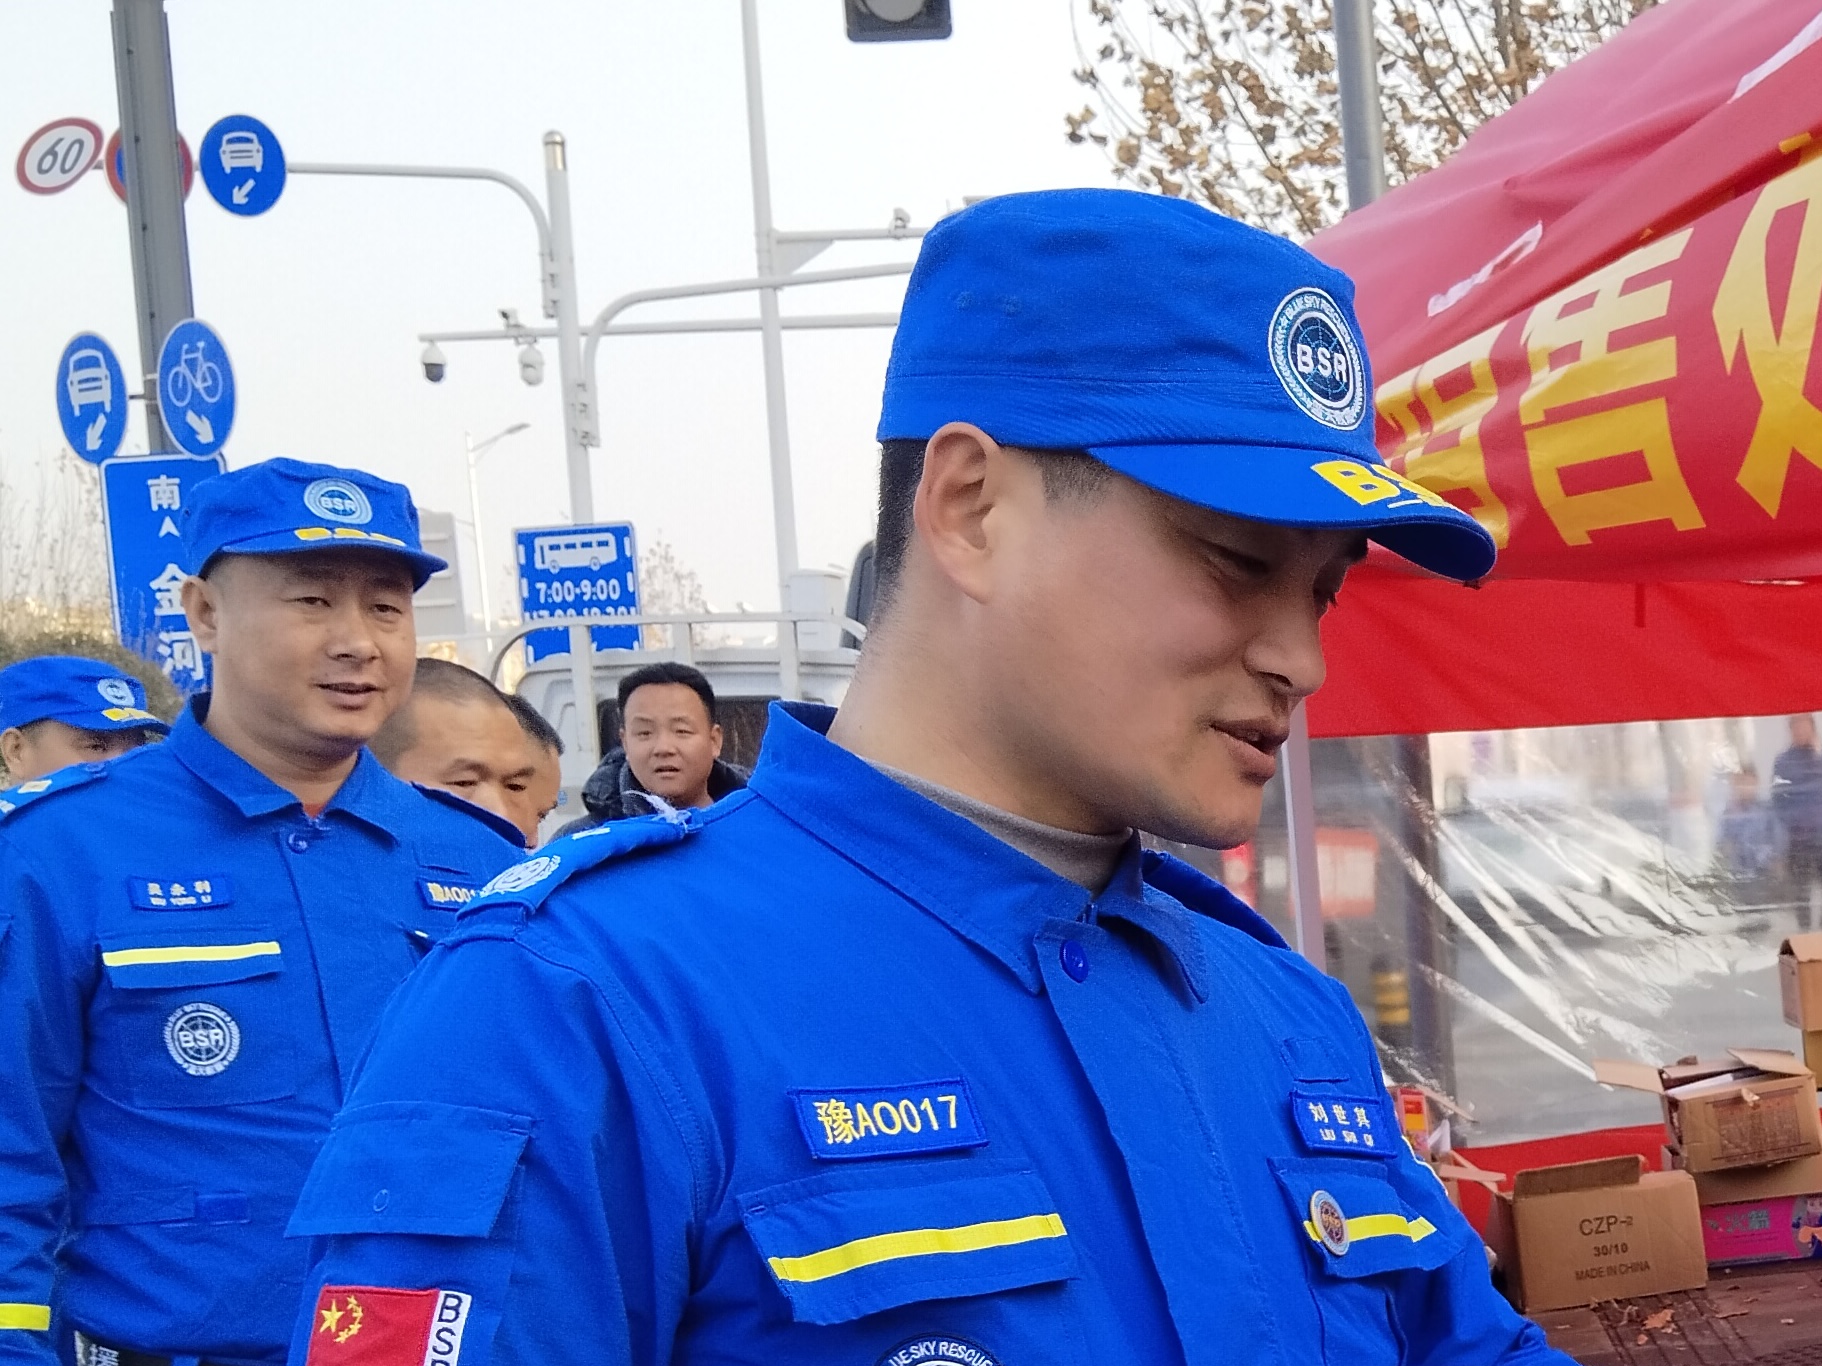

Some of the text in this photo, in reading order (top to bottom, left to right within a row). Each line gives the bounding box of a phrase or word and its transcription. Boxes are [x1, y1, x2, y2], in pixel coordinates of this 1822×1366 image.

[36, 137, 85, 175] 60
[1297, 343, 1349, 383] BSR
[148, 474, 181, 511] 南
[535, 578, 620, 603] 7:00-9:00
[179, 1028, 225, 1048] BSR
[1593, 1242, 1629, 1257] 30/10
[1575, 1260, 1651, 1280] MADE IN CHINA
[911, 1341, 937, 1359] SKY
